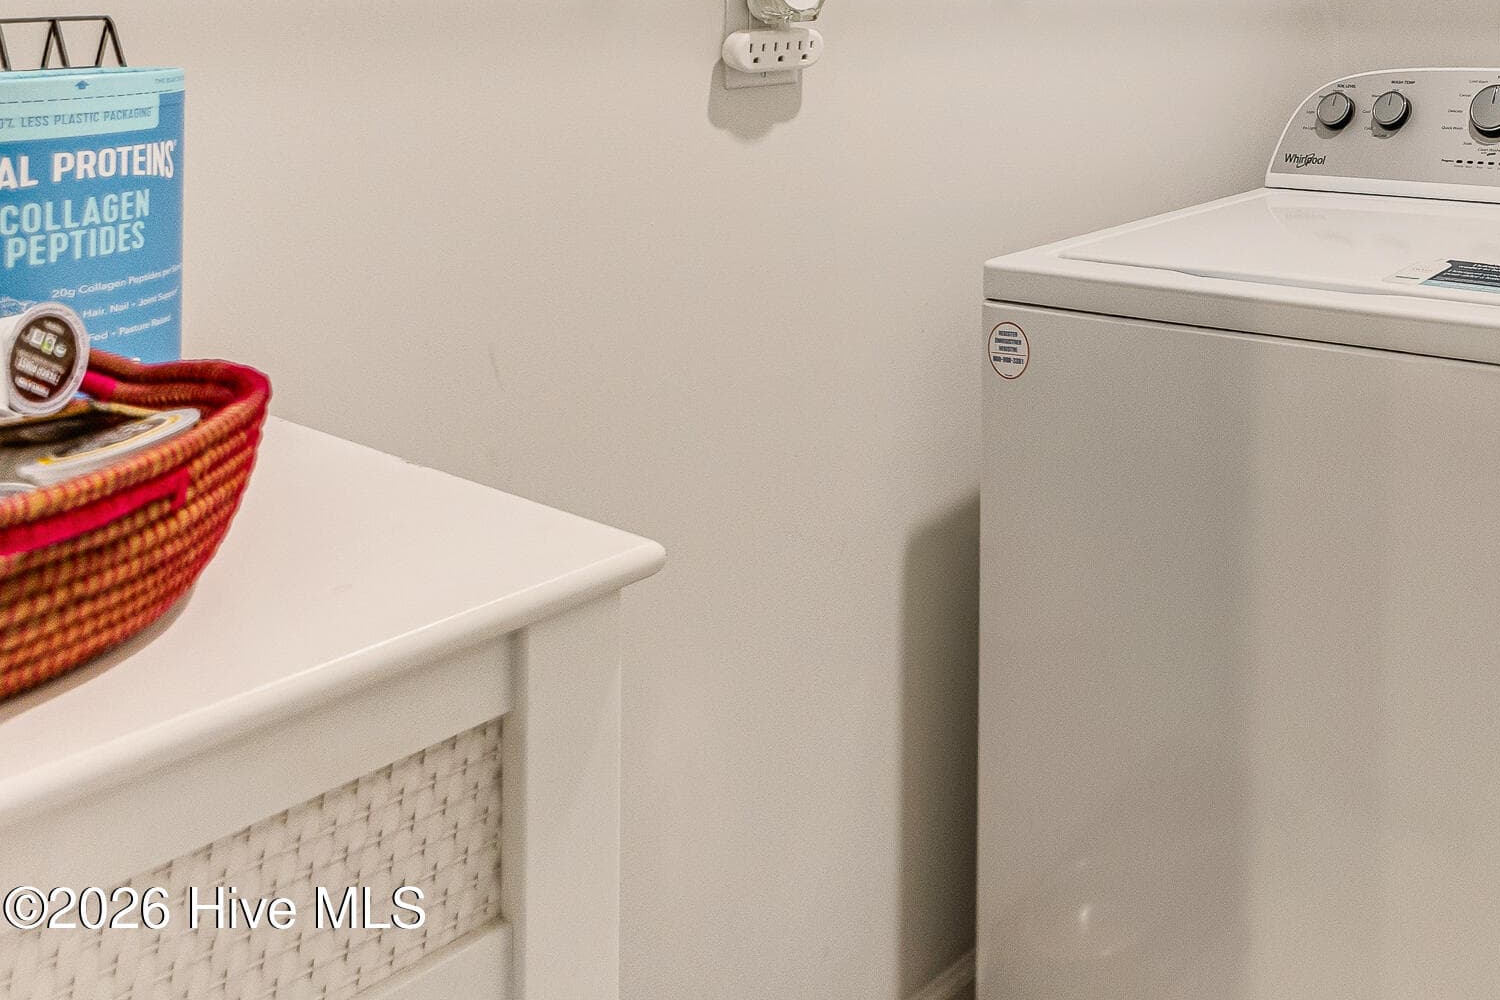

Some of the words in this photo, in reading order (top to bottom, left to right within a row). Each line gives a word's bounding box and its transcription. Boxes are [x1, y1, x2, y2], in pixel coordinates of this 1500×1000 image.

[21, 115, 49, 128] LESS
[54, 113, 100, 126] PLASTIC
[104, 107, 153, 122] PACKAGING
[0, 155, 39, 190] AL
[53, 140, 175, 182] PROTEINS
[1285, 153, 1326, 169] Whirlpool
[2, 188, 150, 236] COLLAGEN
[6, 220, 146, 268] PEPTIDES
[51, 288, 76, 299] 20g
[78, 279, 127, 294] Collagen
[110, 302, 129, 313] Nail
[119, 323, 151, 335] Pasture
